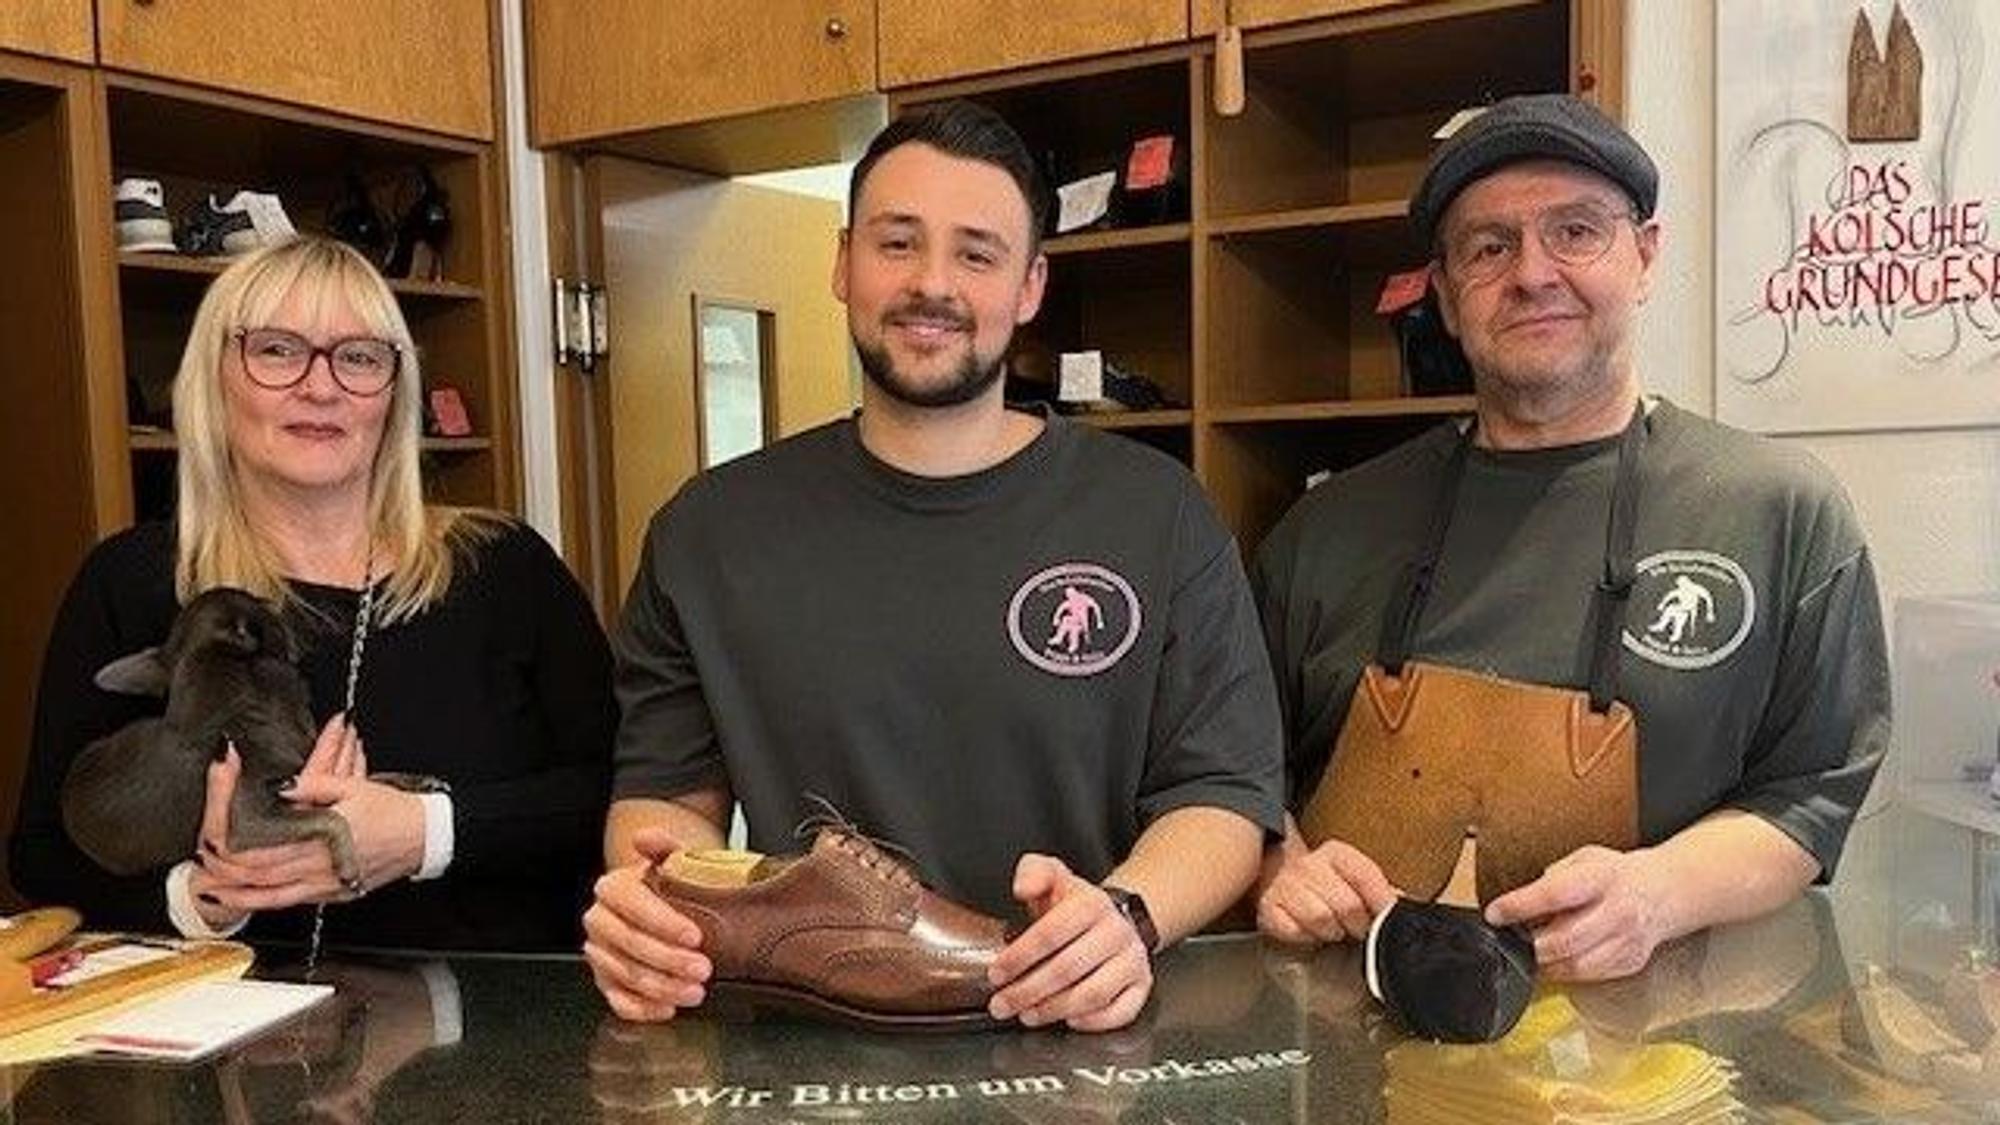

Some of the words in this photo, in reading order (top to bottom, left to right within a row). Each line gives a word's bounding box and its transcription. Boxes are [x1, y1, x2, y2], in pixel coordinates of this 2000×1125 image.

[1850, 162, 1911, 206] DAS
[671, 1086, 773, 1108] Wir
[789, 1082, 961, 1106] Bitten
[978, 1072, 1065, 1096] um
[1072, 1048, 1312, 1087] Vorkasse
